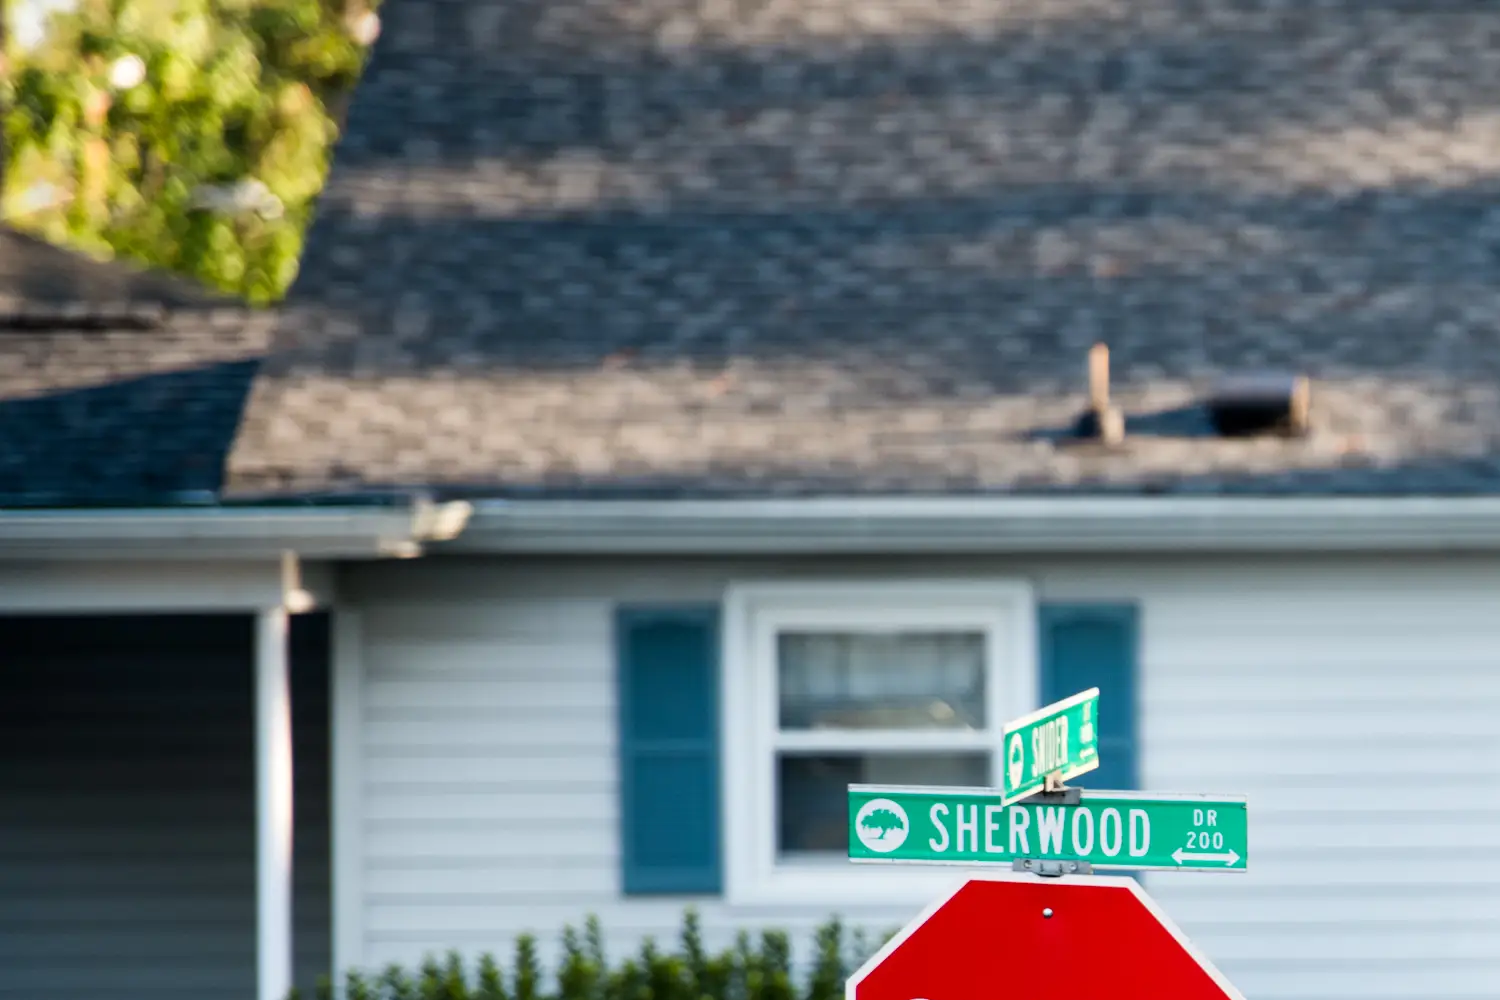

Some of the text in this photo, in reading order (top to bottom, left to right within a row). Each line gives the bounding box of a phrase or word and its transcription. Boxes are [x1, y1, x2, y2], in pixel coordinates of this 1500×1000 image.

[929, 803, 1217, 857] SHERWOOD DR
[1186, 832, 1223, 850] 200
